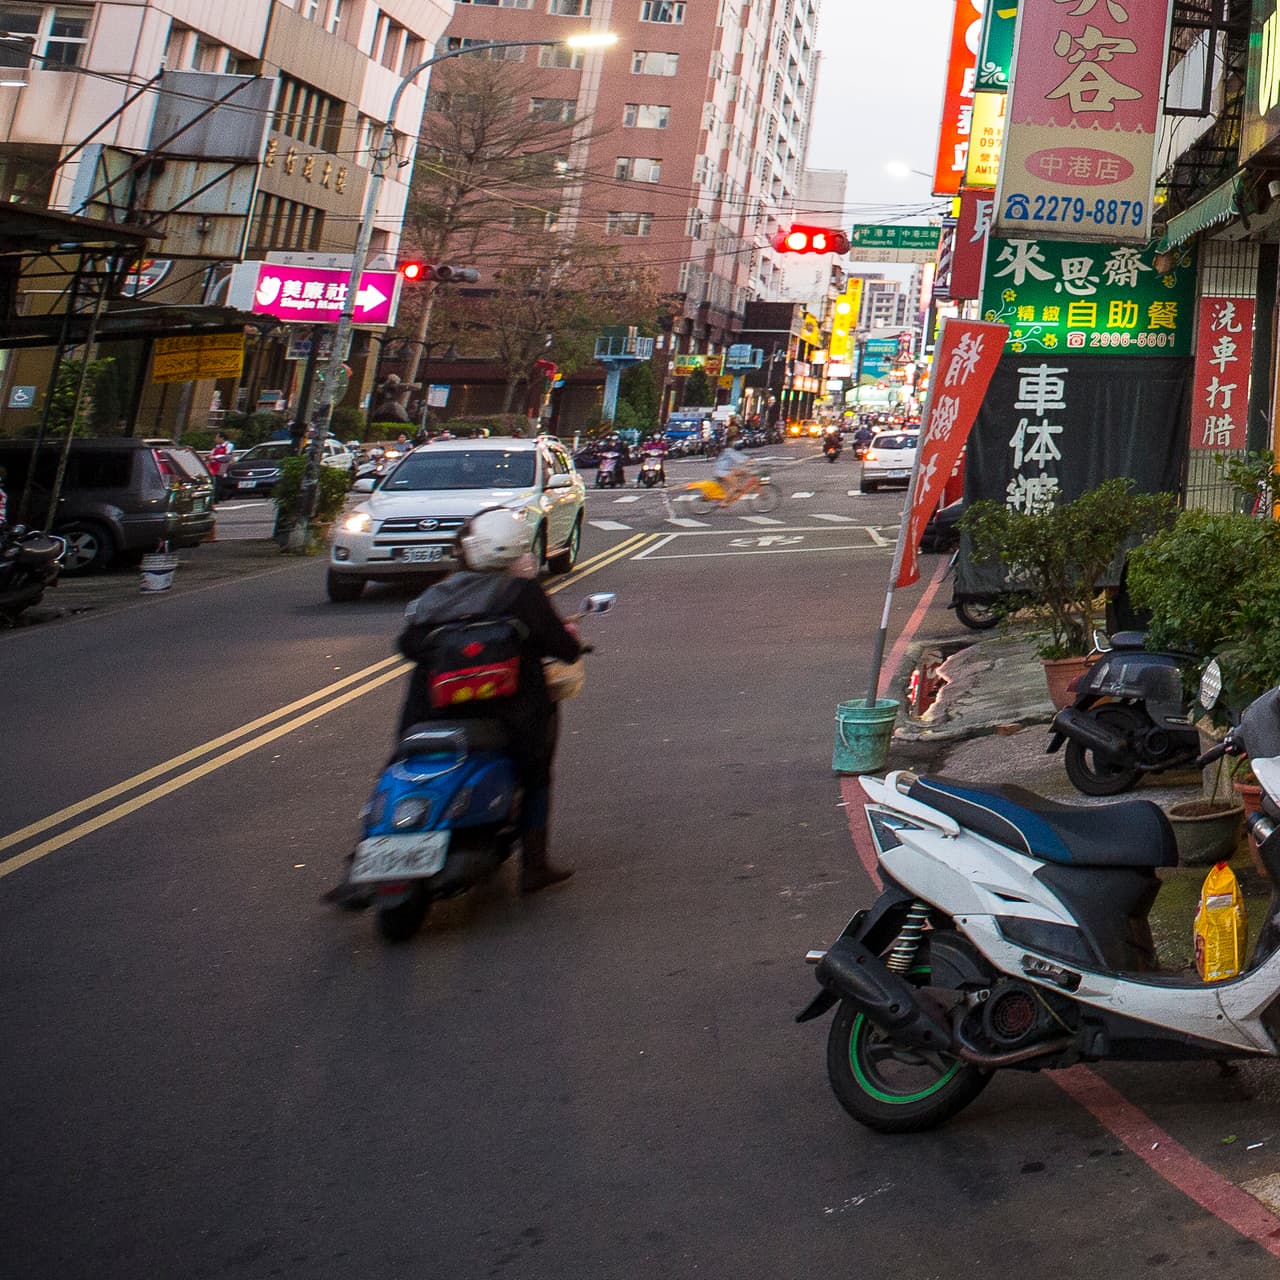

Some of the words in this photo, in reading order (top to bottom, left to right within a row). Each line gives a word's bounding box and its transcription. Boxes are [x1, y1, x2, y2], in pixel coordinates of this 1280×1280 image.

[1038, 152, 1121, 183] 中港店
[1033, 195, 1144, 227] 2279-8879
[281, 280, 349, 301] 美廉社
[1016, 304, 1061, 322] 精緻
[1066, 300, 1178, 330] 自助餐
[1089, 331, 1175, 349] 2996-5601
[1201, 300, 1243, 447] 洗車打腊
